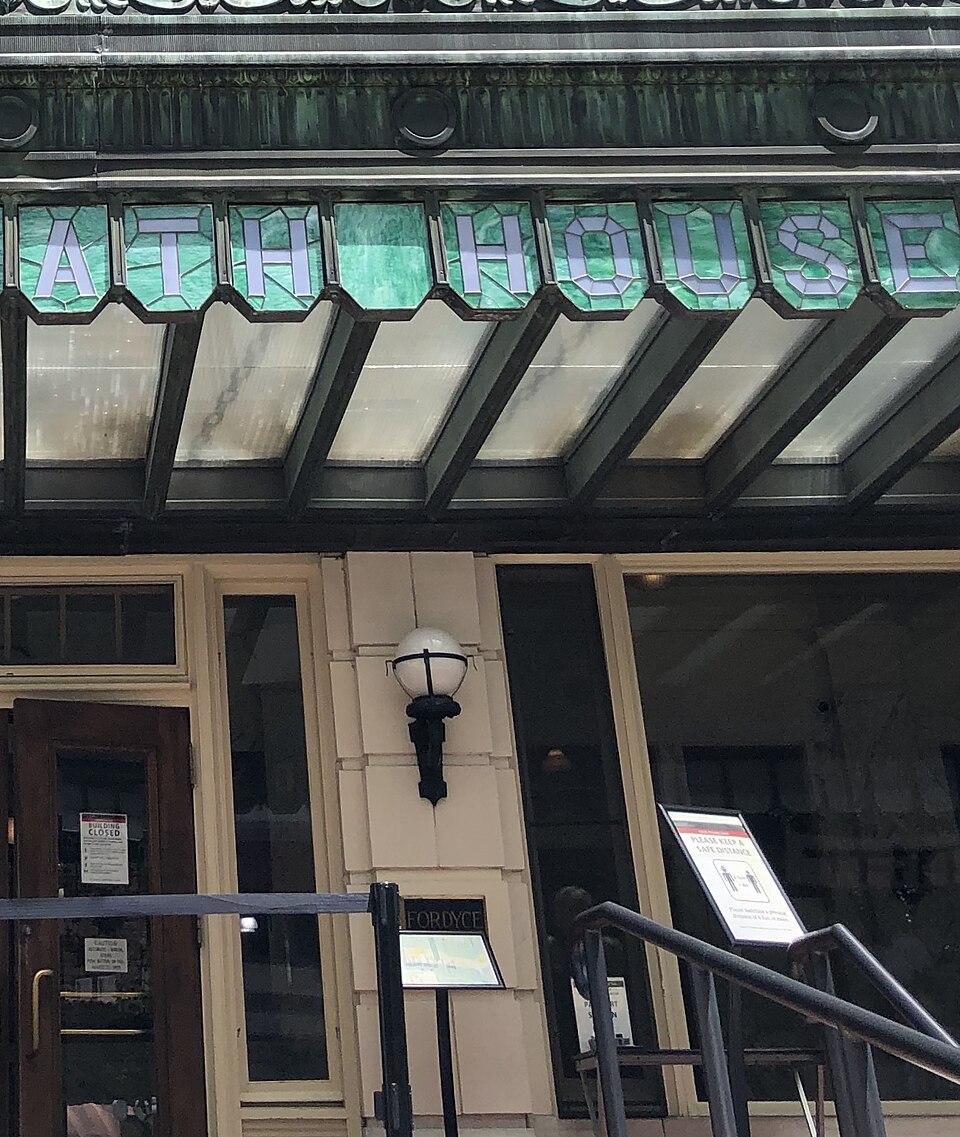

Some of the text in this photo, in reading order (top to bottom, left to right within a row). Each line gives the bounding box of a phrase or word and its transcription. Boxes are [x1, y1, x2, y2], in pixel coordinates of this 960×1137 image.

[456, 213, 959, 296] HOUSE
[88, 829, 120, 837] CLOSED
[690, 836, 718, 845] PLEASE
[718, 837, 737, 846] KEEP
[696, 845, 752, 857] SAFE DISTANCE
[406, 910, 484, 930] FORDYCE
